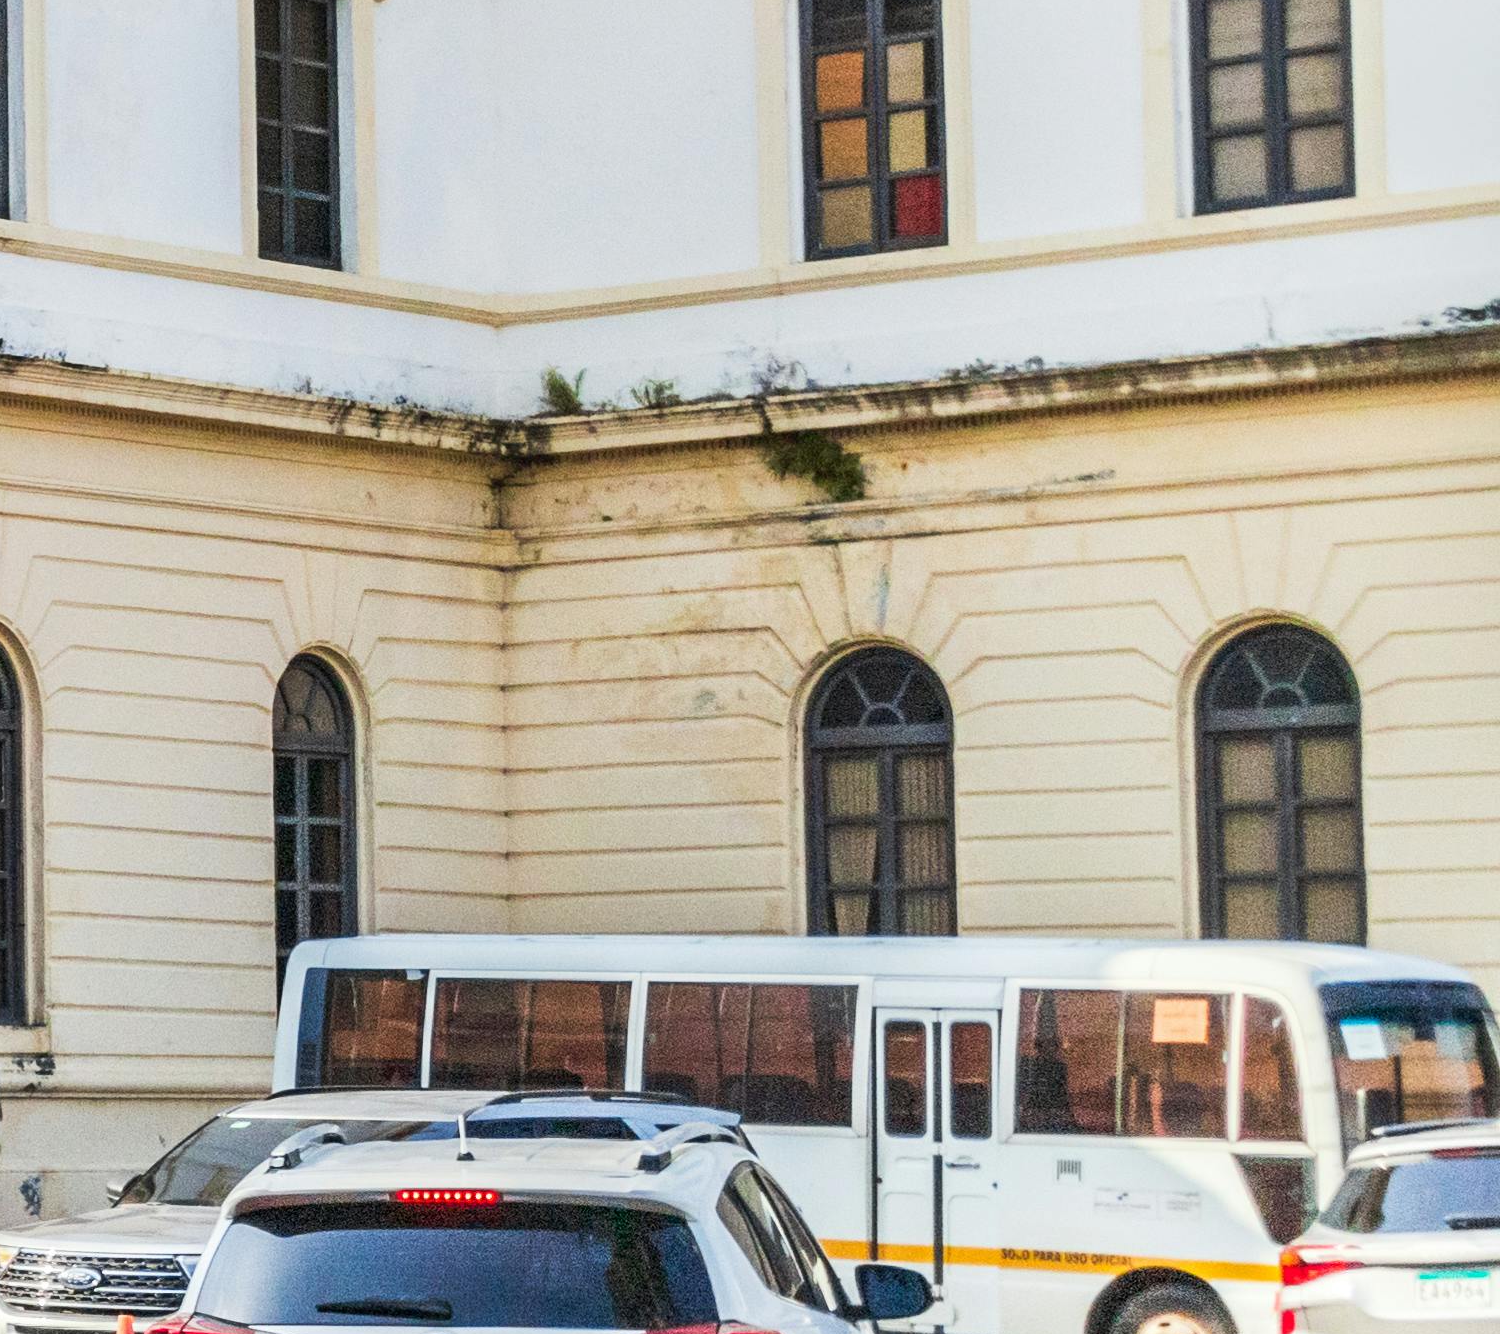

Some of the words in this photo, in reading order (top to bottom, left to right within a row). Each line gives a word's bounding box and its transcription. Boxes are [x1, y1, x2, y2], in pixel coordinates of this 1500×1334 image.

[1033, 1249, 1061, 1263] PARA
[1064, 1252, 1088, 1265] USO
[1090, 1254, 1133, 1266] OFICIAL
